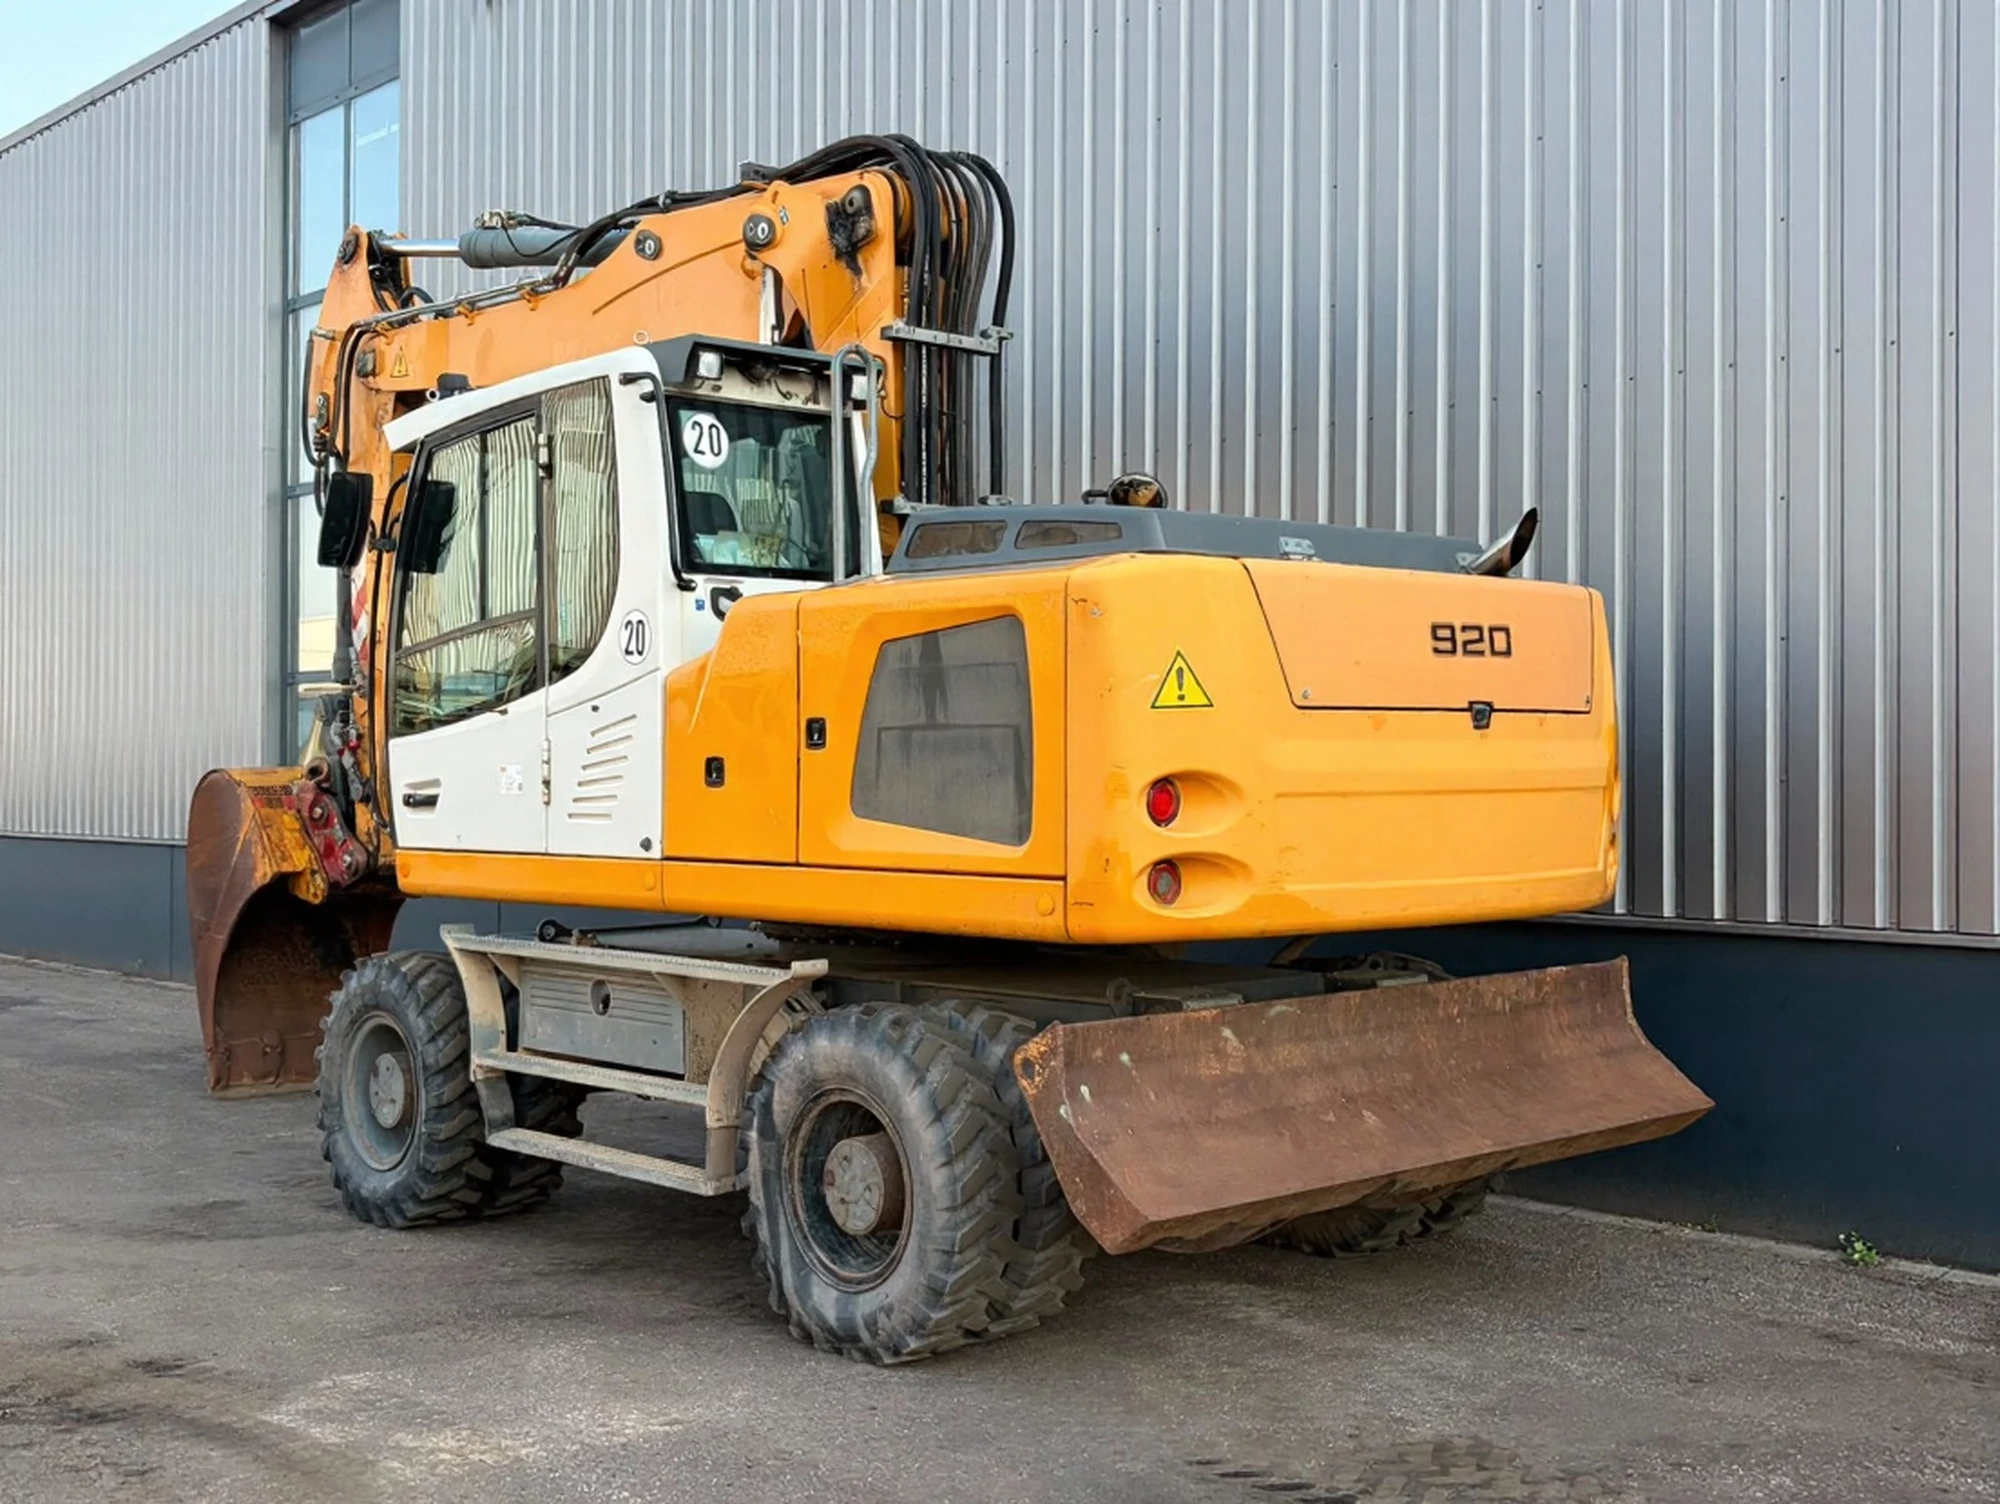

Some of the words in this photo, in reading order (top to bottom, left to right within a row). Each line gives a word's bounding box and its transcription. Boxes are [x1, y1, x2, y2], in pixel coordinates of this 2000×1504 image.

[691, 420, 722, 457] 20
[624, 619, 646, 656] 20
[1431, 622, 1512, 657] 920
